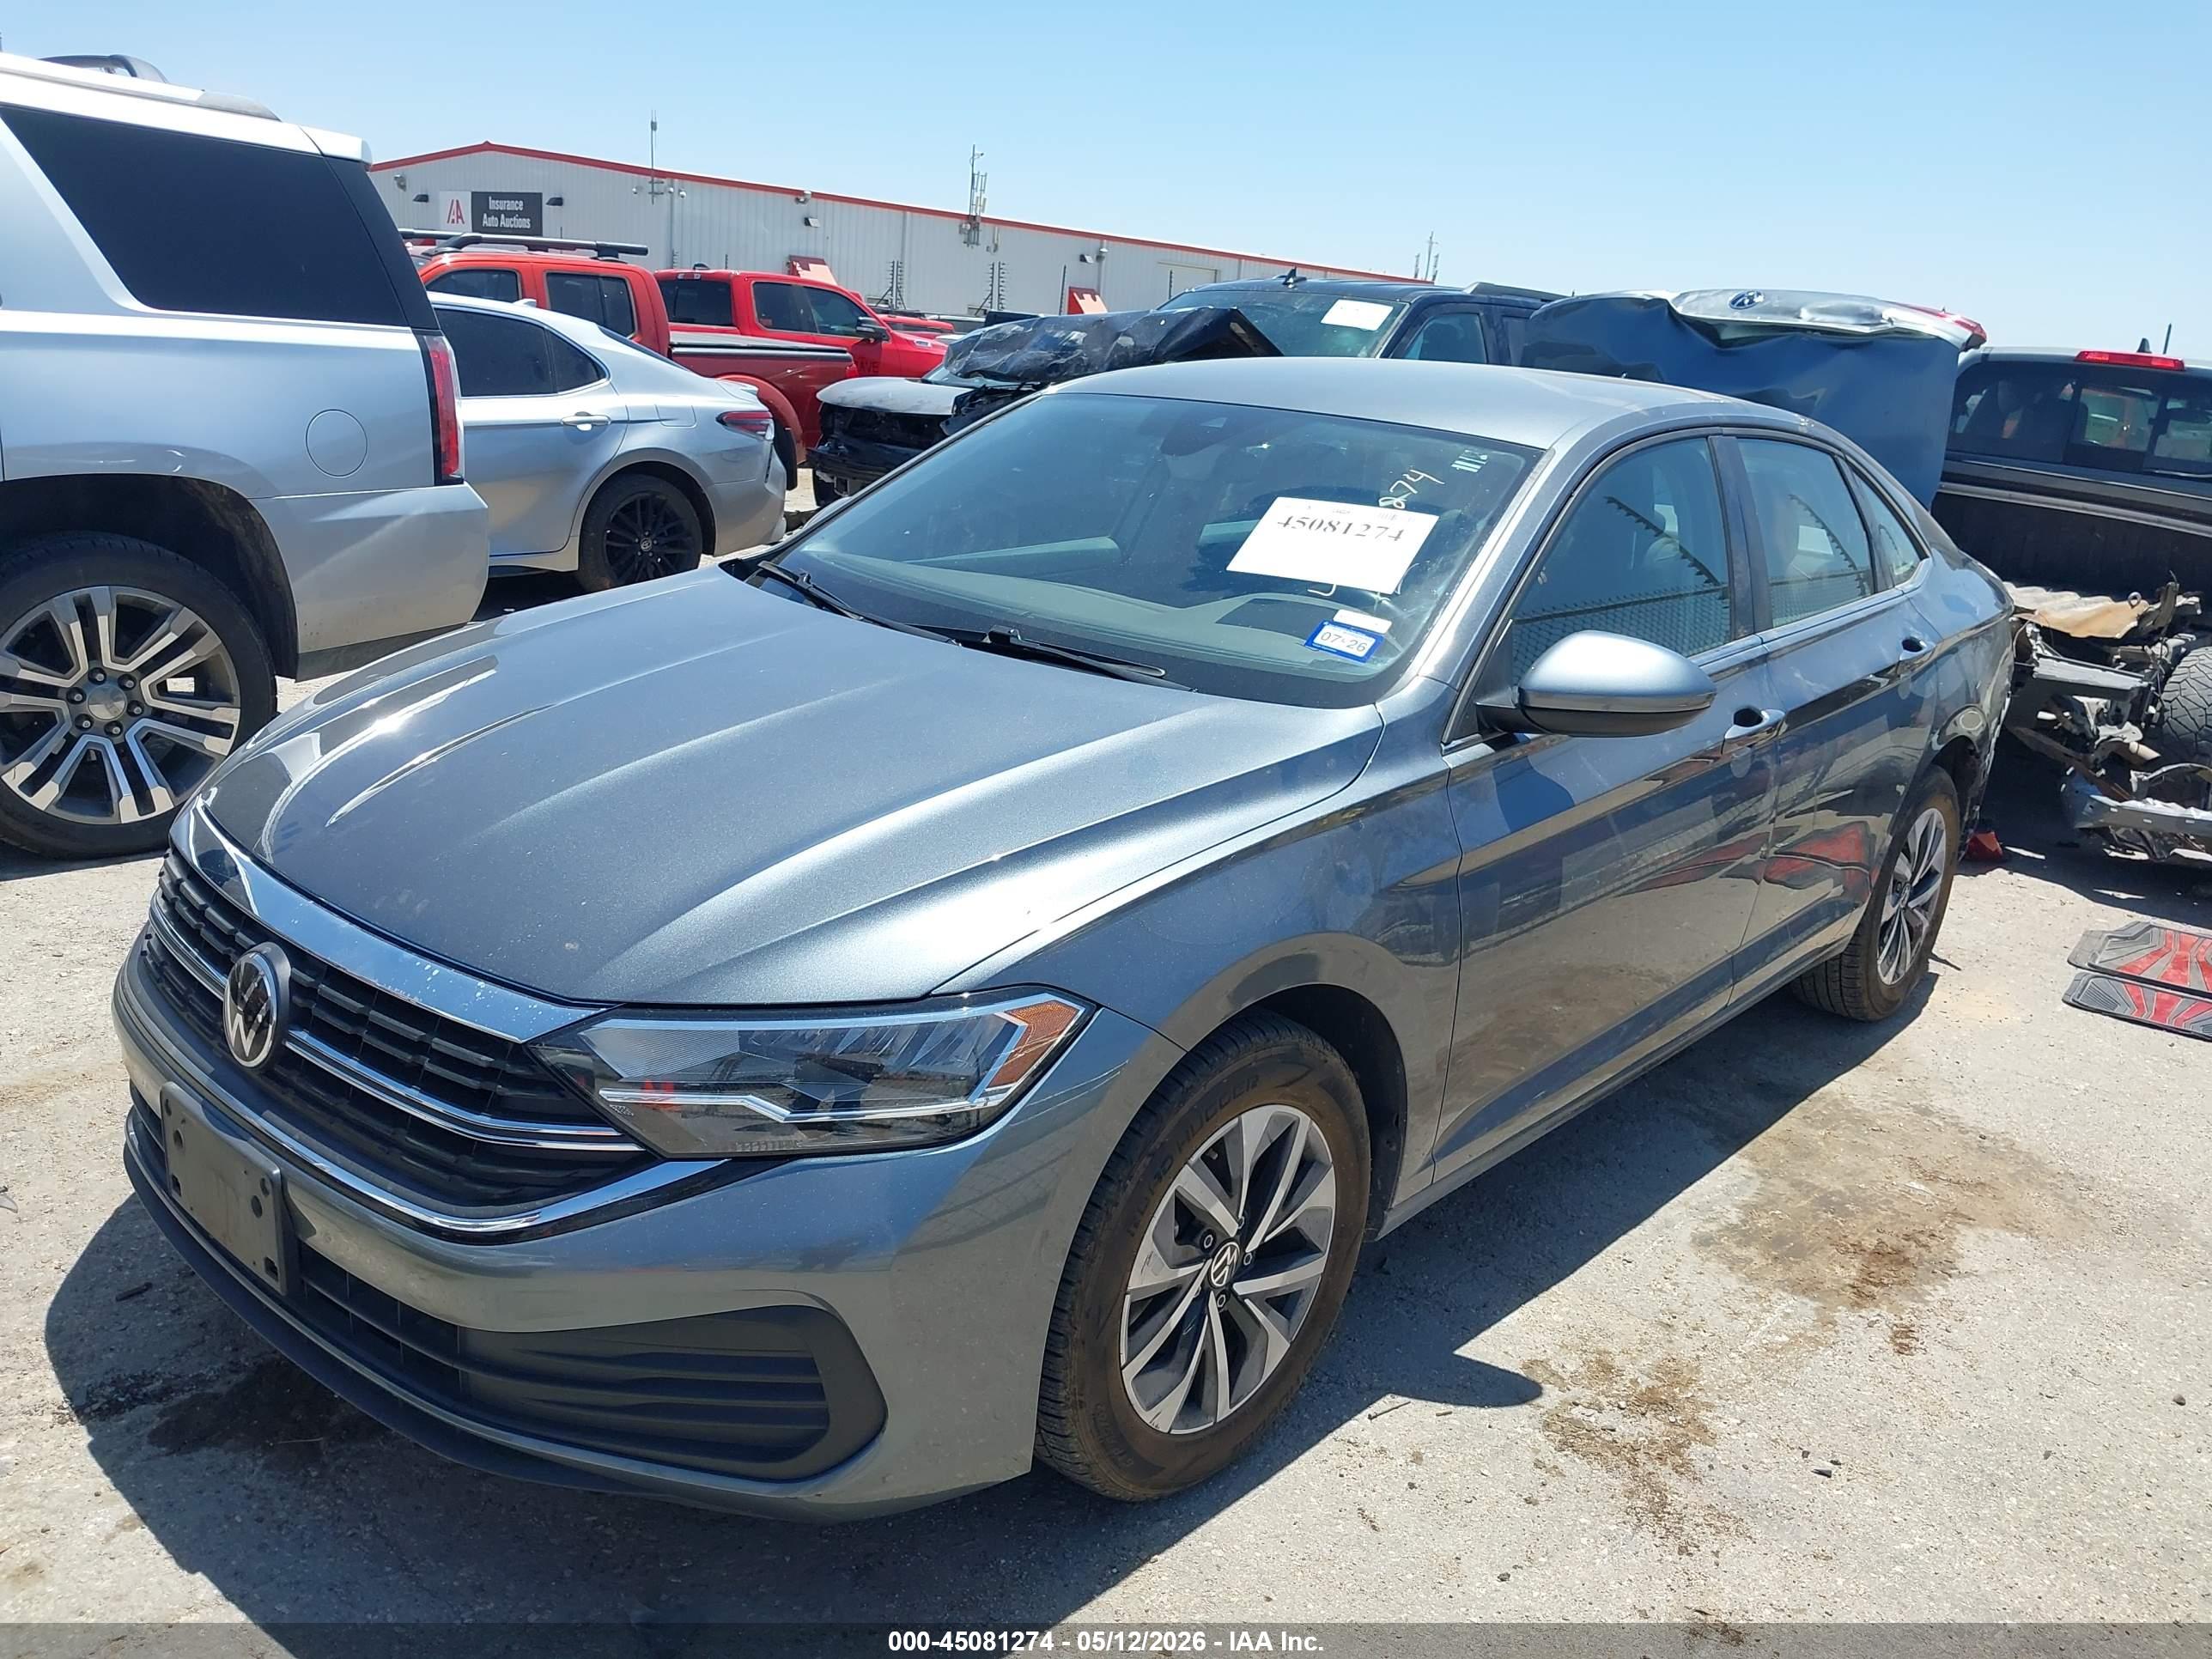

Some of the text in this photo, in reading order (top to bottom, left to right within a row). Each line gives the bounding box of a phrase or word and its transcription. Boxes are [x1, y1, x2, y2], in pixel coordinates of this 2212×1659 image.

[488, 196, 524, 211] Insurance
[482, 213, 532, 229] Auto Auctions
[1277, 515, 1405, 542] 45081274
